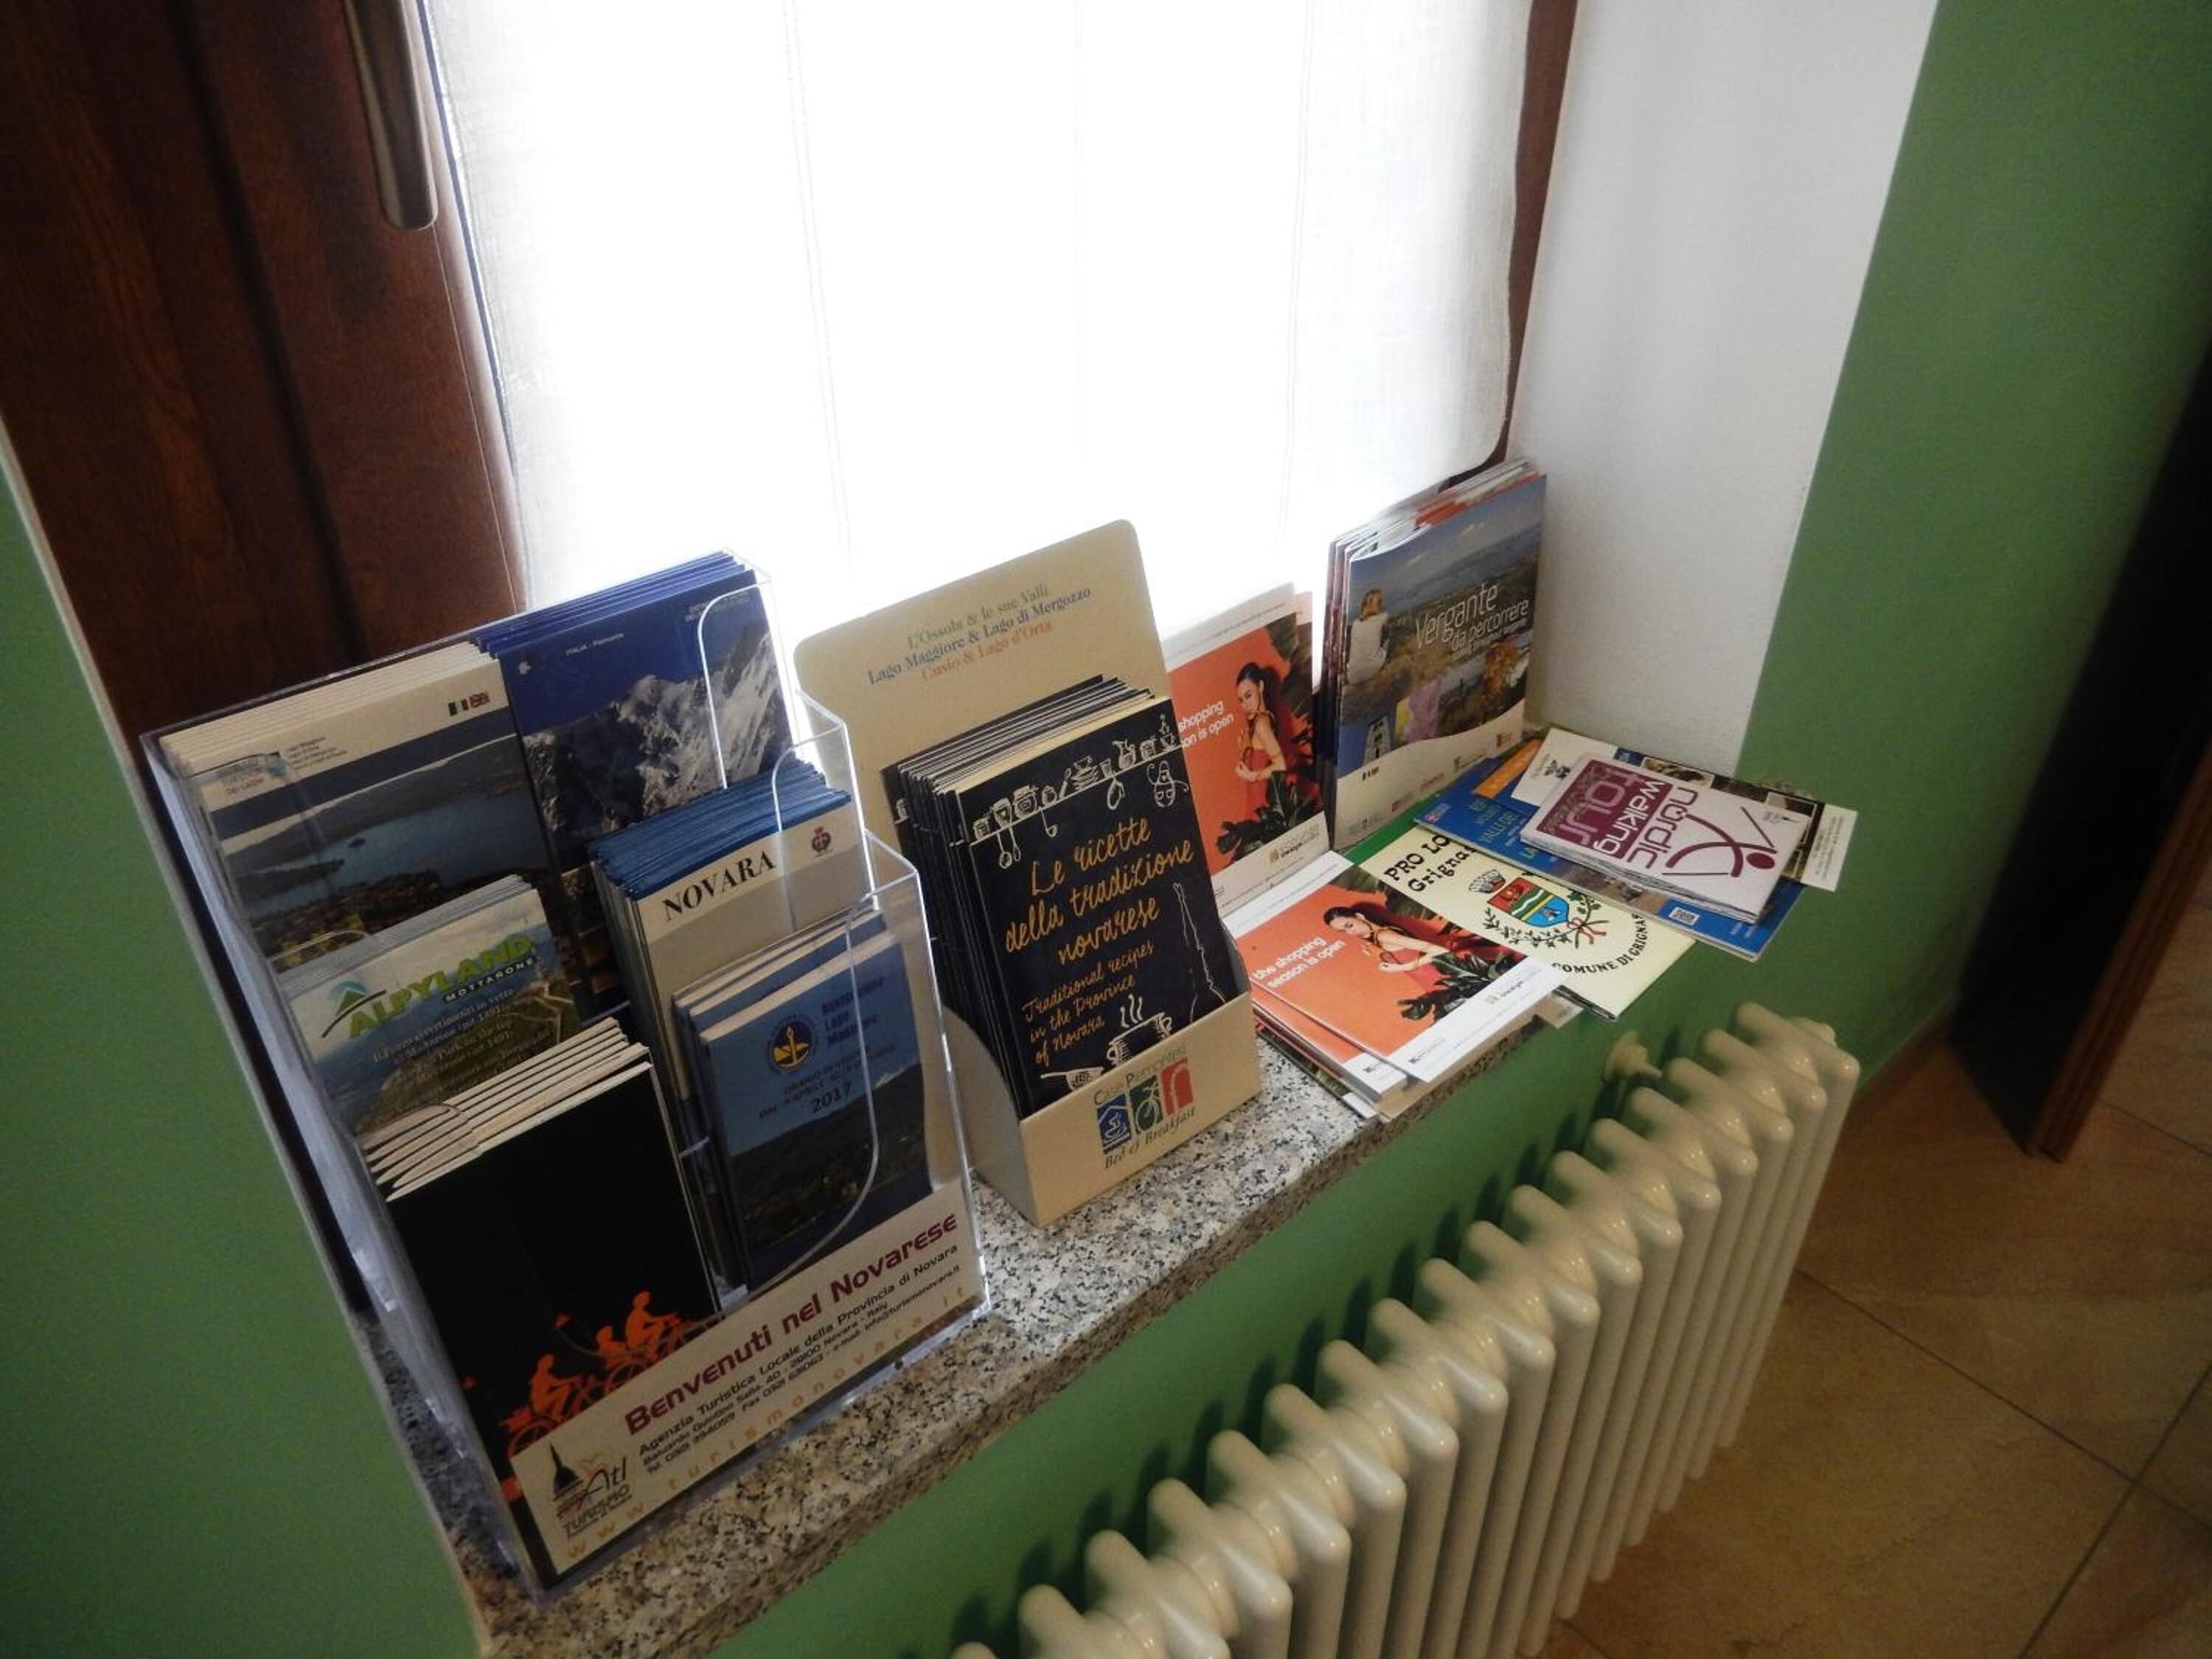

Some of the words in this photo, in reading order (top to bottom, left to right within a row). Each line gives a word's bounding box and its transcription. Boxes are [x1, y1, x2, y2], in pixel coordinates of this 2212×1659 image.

[868, 662, 902, 685] Lago
[905, 637, 965, 669] Maggiore
[967, 631, 981, 644] &
[982, 618, 1015, 638] Lago
[1017, 608, 1029, 625] di
[1032, 588, 1091, 616] Mergozzo
[1415, 582, 1499, 650] Vergante
[1208, 713, 1234, 735] open
[1593, 779, 1666, 856] walking
[1627, 786, 1699, 870] nordic
[661, 849, 776, 922] NOVARA
[1032, 860, 1065, 897] Le
[1074, 817, 1151, 872] ricette
[1383, 852, 1425, 882] PRO
[1006, 900, 1064, 953] della
[1069, 840, 1194, 917] tradizione
[1058, 897, 1160, 965] novarese
[1266, 963, 1310, 988] season
[1317, 939, 1346, 959] open
[1275, 936, 1326, 968] shopping
[1616, 953, 1634, 966] DI
[349, 934, 536, 1040] ALPYLAND
[445, 956, 535, 1003] MOTTARONE
[1022, 963, 1105, 1023] Traditional
[1107, 939, 1156, 973] recipes
[1049, 1006, 1071, 1031] the
[1035, 1043, 1050, 1067] of
[813, 1081, 852, 1113] 2017
[625, 1324, 773, 1436] Benvenuti
[782, 1293, 822, 1335] nel
[830, 1214, 958, 1304] Novarese
[639, 1415, 694, 1456] Agenzia
[696, 1374, 757, 1415] Turistica
[759, 1344, 800, 1375] Locale
[804, 1324, 834, 1347] della
[838, 1284, 902, 1326] Provincia
[899, 1273, 911, 1287] di
[914, 1245, 958, 1277] Novara
